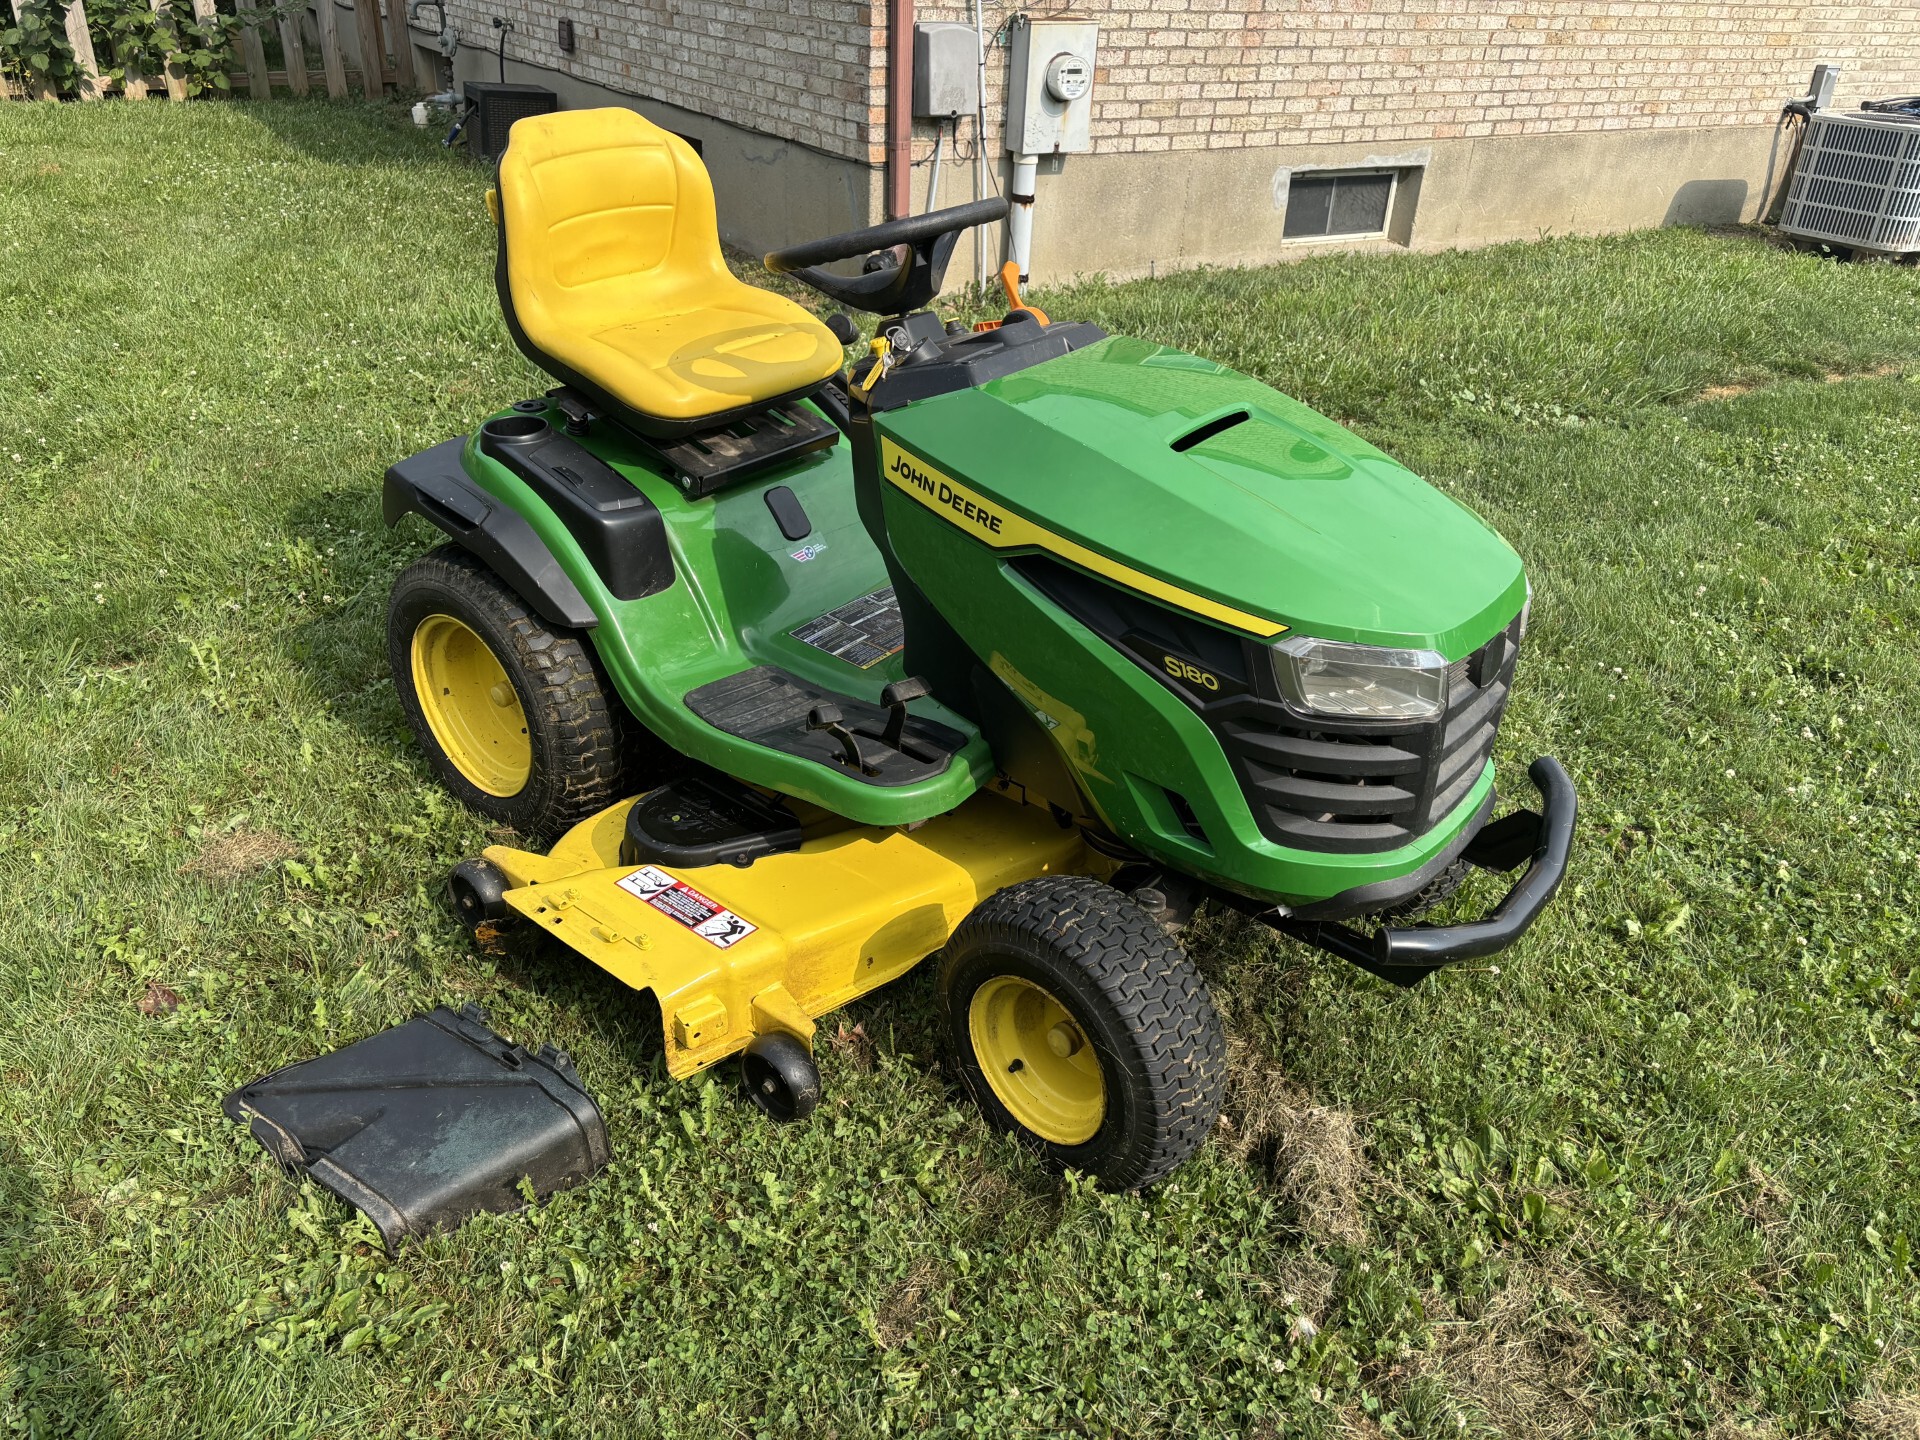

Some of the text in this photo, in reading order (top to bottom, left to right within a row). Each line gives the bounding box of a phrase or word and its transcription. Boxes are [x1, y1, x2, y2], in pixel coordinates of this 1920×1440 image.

[891, 455, 1003, 535] JOHN DEERE
[1164, 655, 1219, 691] S180
[687, 889, 718, 909] DANGER
